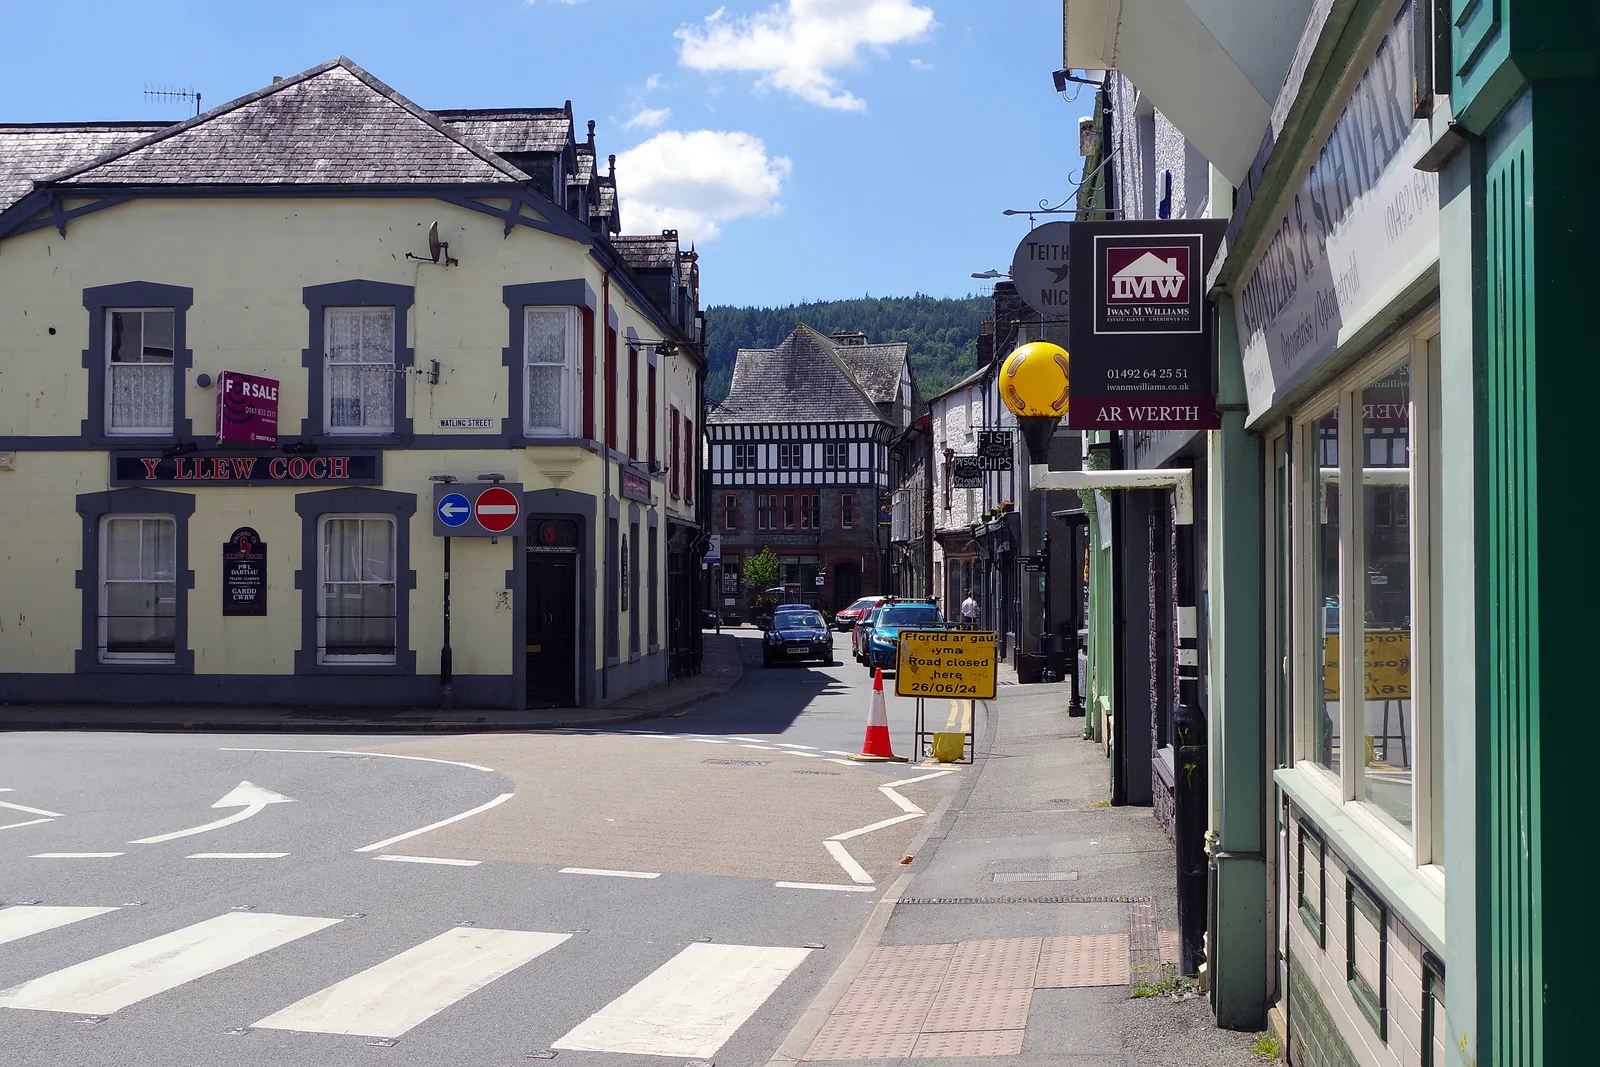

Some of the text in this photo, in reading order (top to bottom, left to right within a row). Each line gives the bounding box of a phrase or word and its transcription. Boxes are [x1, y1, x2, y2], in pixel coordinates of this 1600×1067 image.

[1242, 0, 1413, 349] SAUNDERS & SCHWAR
[1027, 242, 1069, 260] TEITH
[1112, 276, 1186, 298] IMW
[1041, 289, 1069, 305] NIC
[1107, 307, 1190, 316] IWAN M WILLIAMS
[1107, 368, 1188, 379] 01492 64 25 51
[252, 384, 277, 400] SALE
[1107, 382, 1190, 391] iwanmwilliams.co.uk
[1096, 406, 1200, 421] AR WERTH
[440, 419, 491, 427] WATLING STREET
[979, 432, 1012, 449] FISH
[141, 456, 350, 480] Y LLEW COCH
[955, 457, 978, 470] PYSGO
[978, 455, 1012, 470] CHIPS
[905, 633, 948, 642] Ffordd
[970, 635, 993, 644] gau
[935, 647, 963, 655] yma
[909, 657, 989, 667] Road closed
[934, 670, 962, 679] here
[911, 682, 976, 693] 26/06/24
